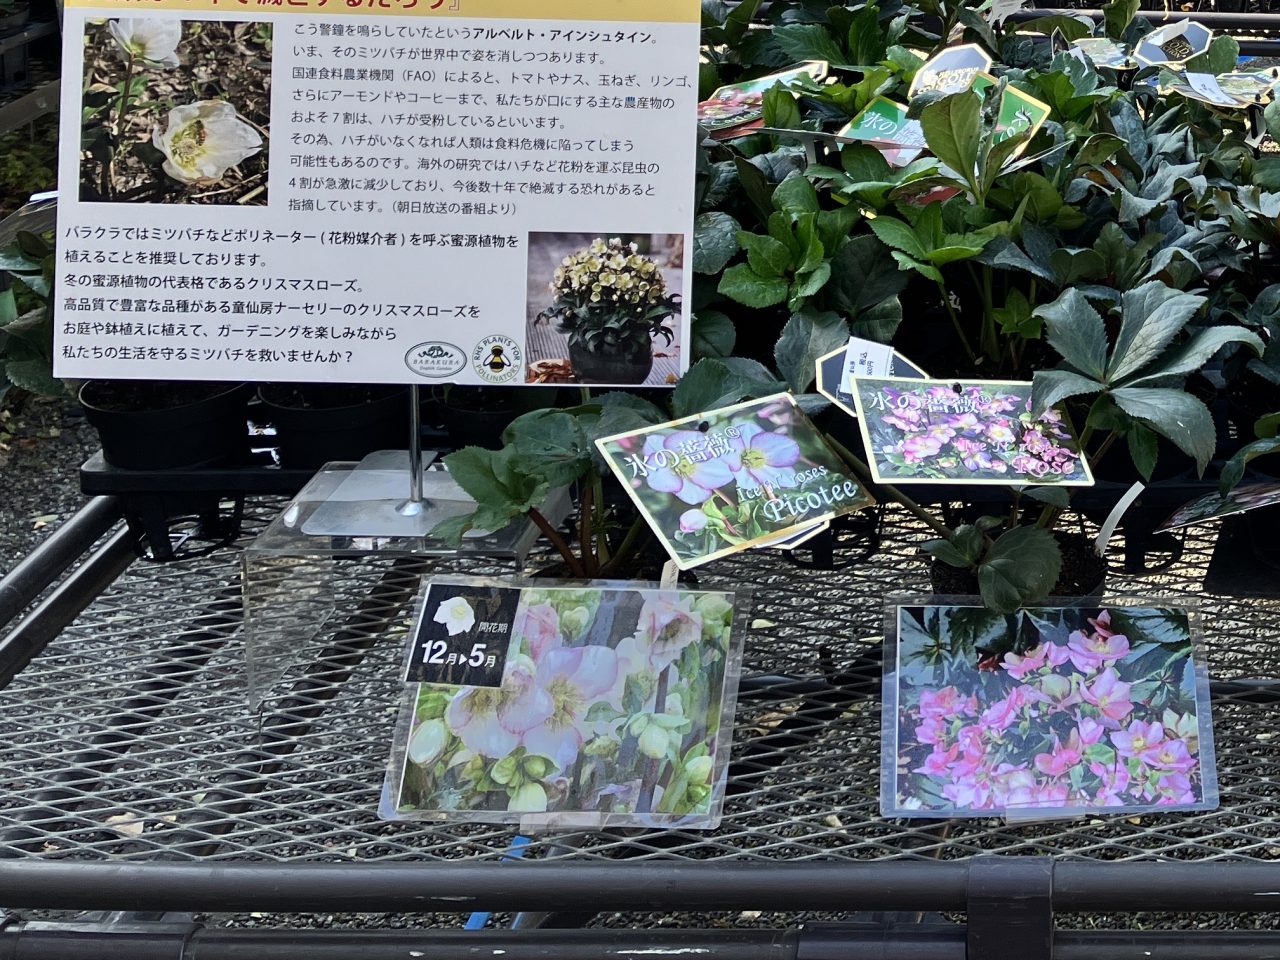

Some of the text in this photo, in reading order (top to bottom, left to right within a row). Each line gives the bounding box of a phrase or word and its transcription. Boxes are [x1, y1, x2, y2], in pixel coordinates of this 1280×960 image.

[293, 45, 605, 65] いま、そのミツバチが世界中で姿を消しつつあります。
[64, 249, 267, 267] 植えることを推奨しております。
[64, 273, 363, 292] 冬の蜜源植物の代表格であるクリスマスローズ。
[474, 336, 520, 361] RHS PLANTS FOR
[412, 358, 460, 366] BARAKURA
[476, 363, 519, 382] POLLINATORS
[1012, 456, 1075, 477] Rose
[736, 484, 761, 503] Ice
[788, 464, 828, 485] roses
[763, 479, 857, 523] Picotee
[479, 621, 508, 634] 開花期
